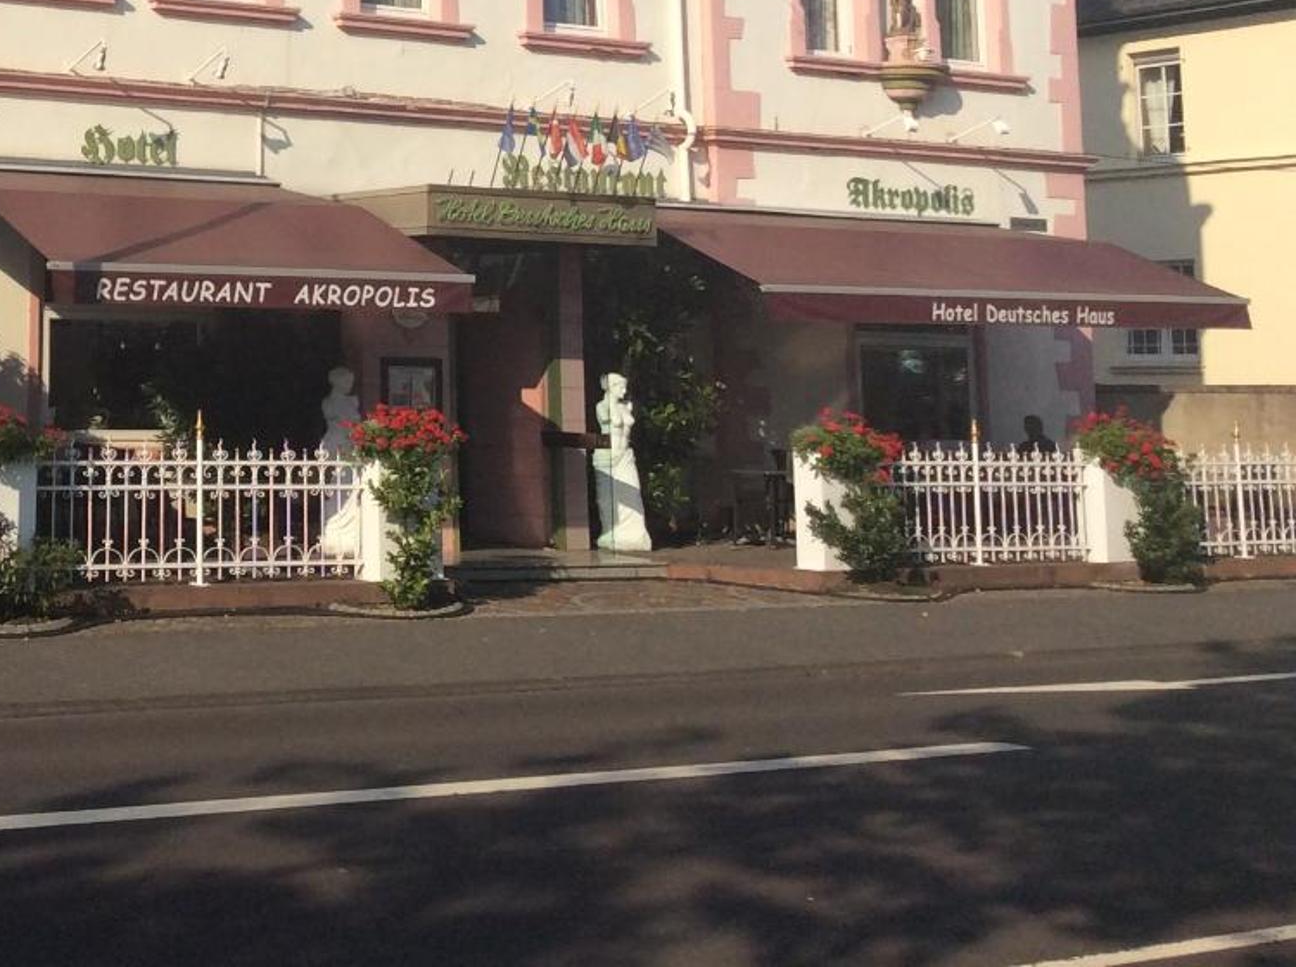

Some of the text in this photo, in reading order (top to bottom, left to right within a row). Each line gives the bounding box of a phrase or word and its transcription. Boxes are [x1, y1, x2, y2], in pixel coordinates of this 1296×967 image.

[81, 123, 177, 166] Hotel
[846, 176, 975, 217] Akropolis
[96, 276, 436, 309] RESTAURANT AKROPOLIS
[931, 301, 1116, 326] Hotel Deutsches Haus
